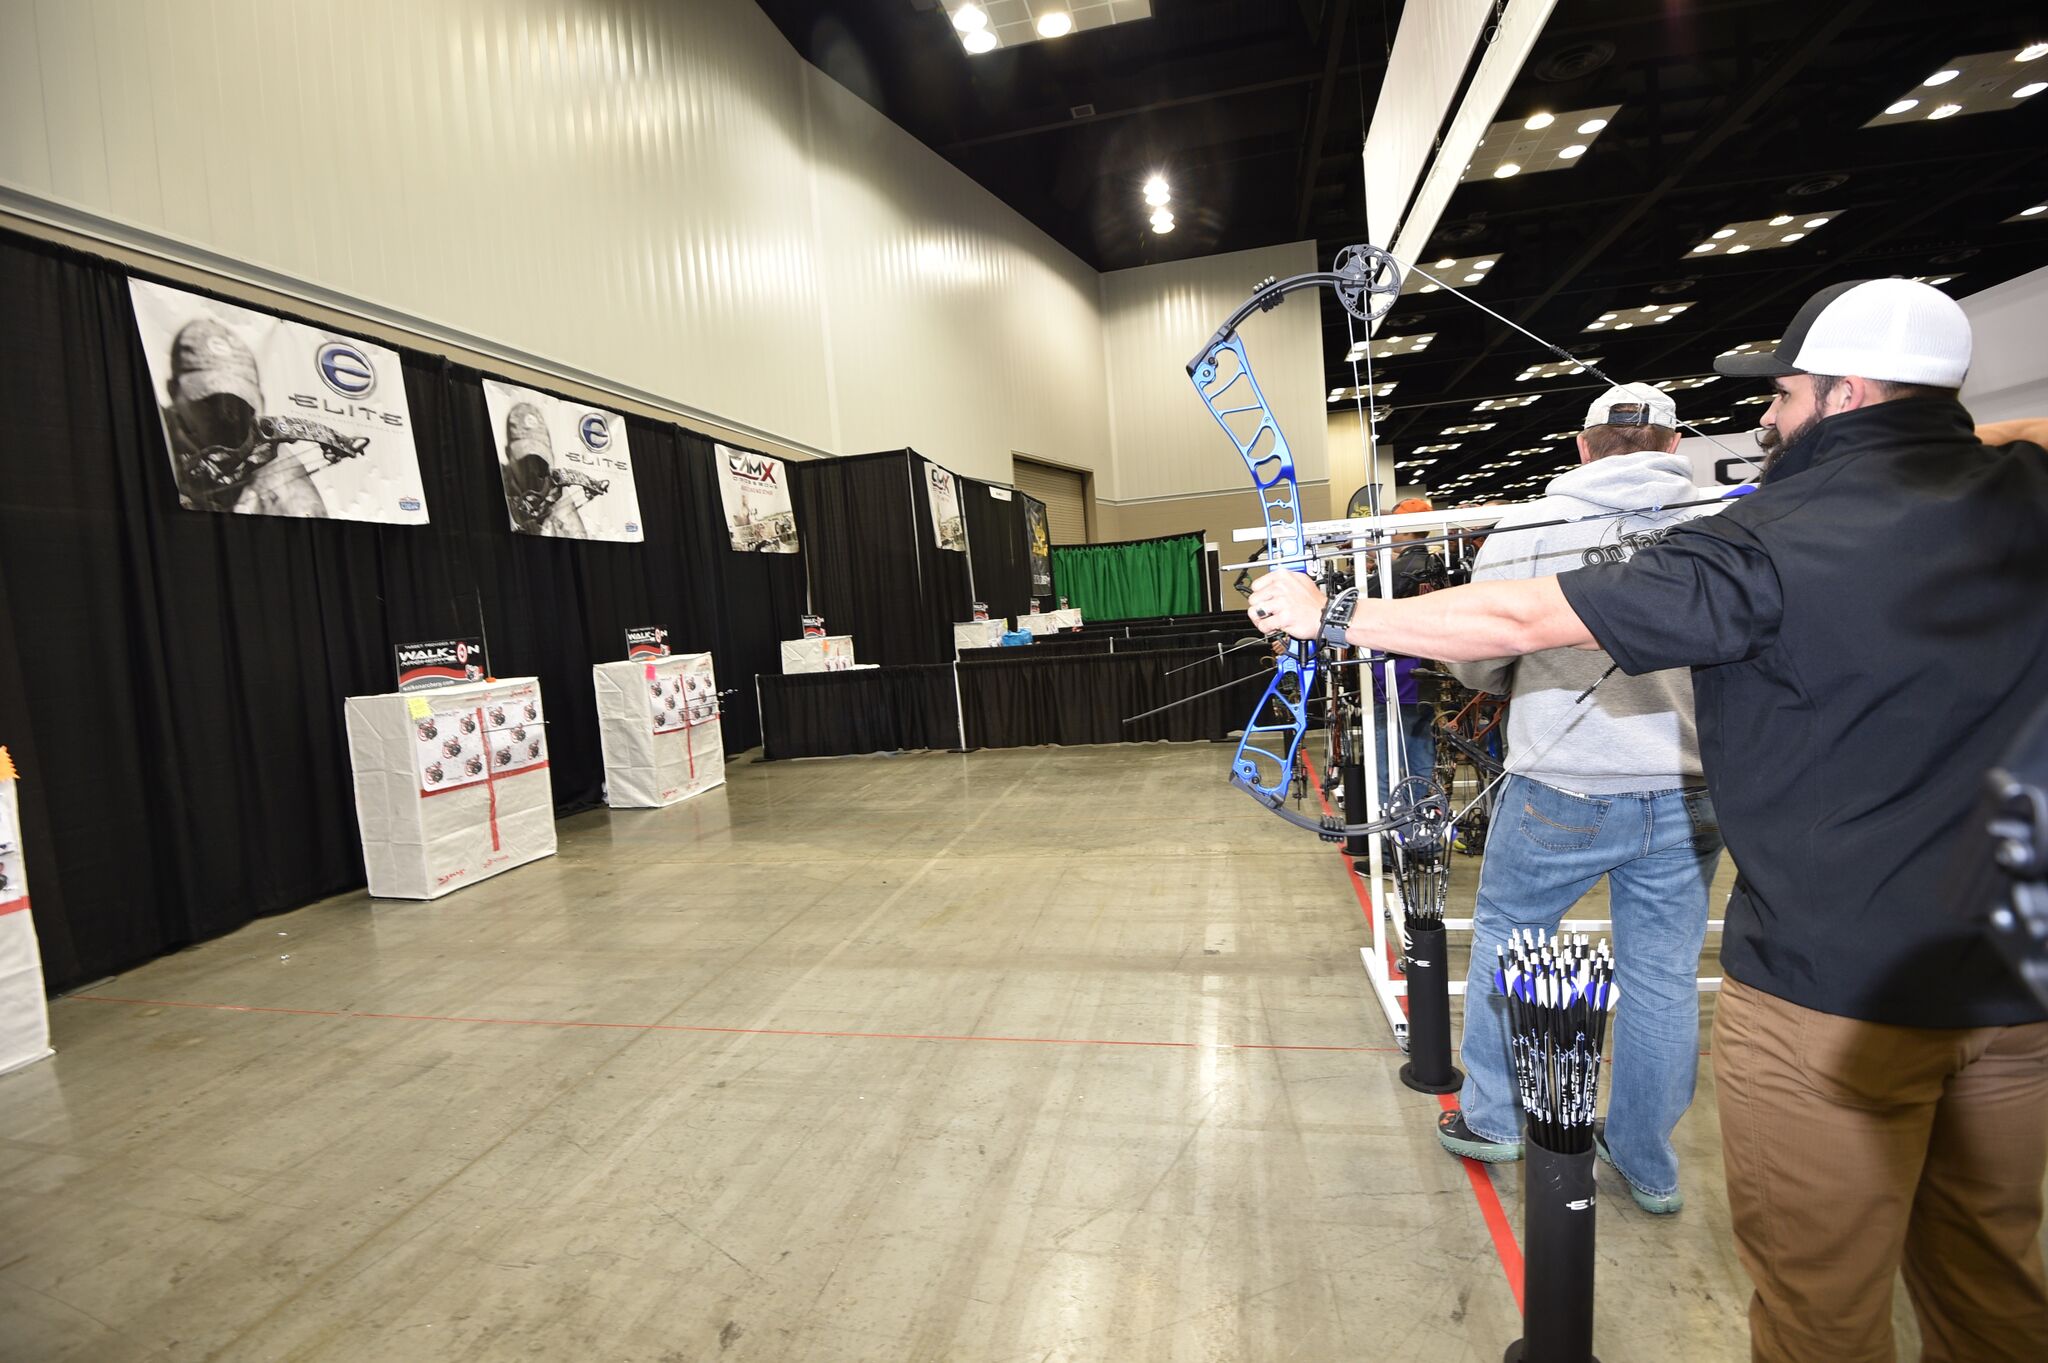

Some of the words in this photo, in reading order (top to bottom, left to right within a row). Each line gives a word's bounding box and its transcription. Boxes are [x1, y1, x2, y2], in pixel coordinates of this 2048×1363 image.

[288, 393, 403, 426] ELITE
[565, 452, 628, 470] ELITE
[728, 455, 777, 484] CAMX
[1582, 544, 1627, 566] On
